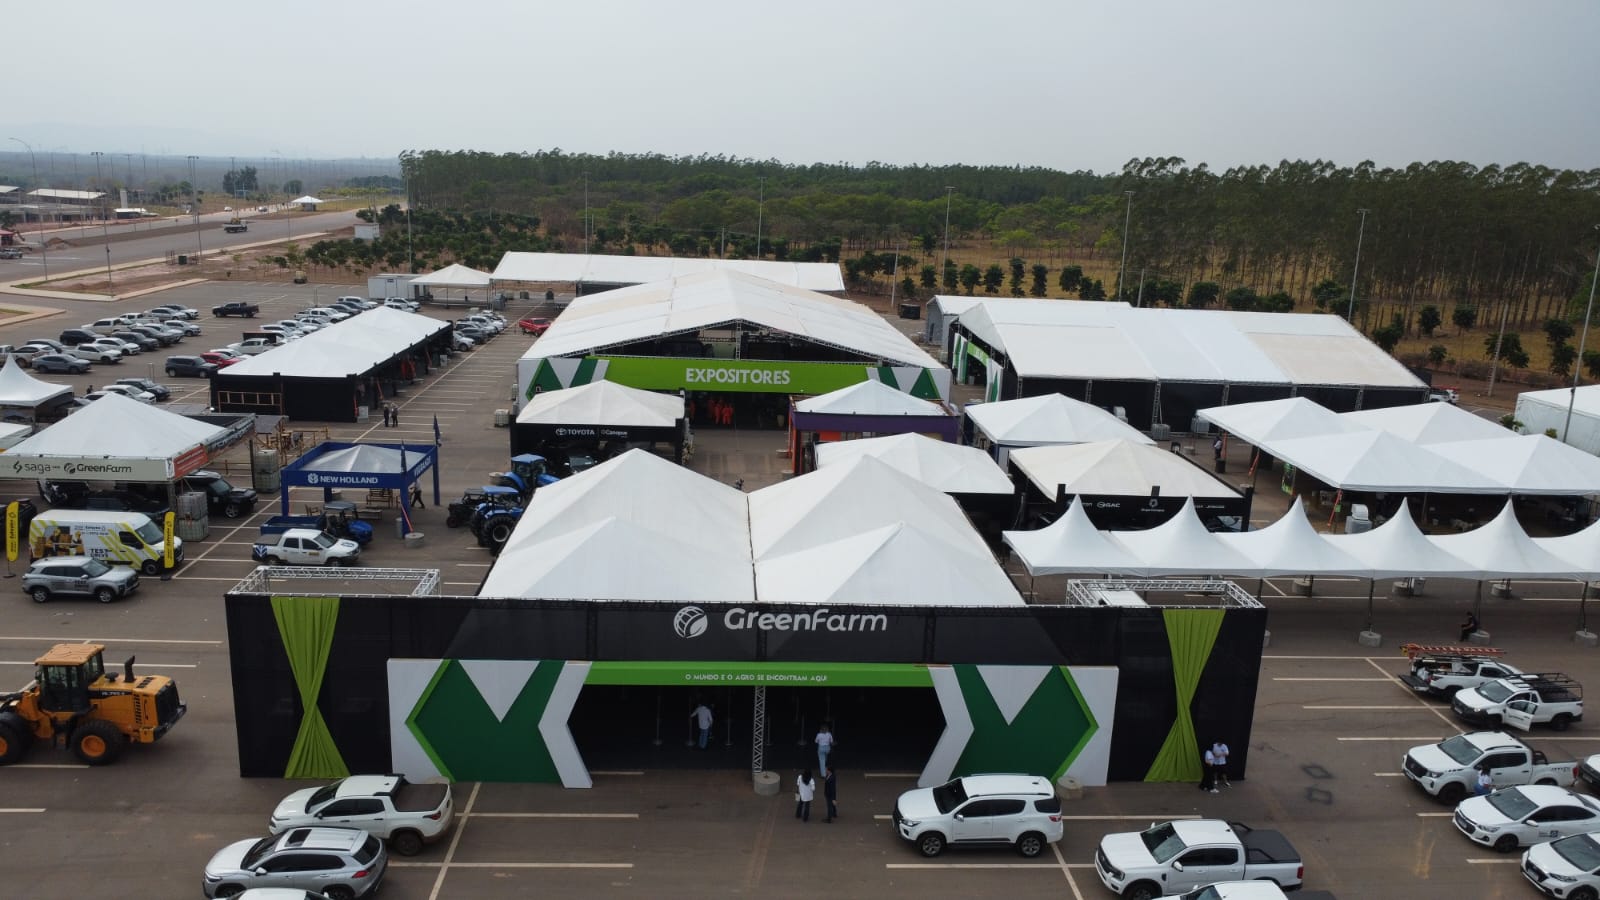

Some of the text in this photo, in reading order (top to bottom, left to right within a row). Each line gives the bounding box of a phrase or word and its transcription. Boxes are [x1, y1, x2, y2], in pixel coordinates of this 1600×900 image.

[685, 368, 791, 385] EXPOSITORES
[24, 463, 51, 474] saga
[76, 463, 132, 473] GreenFarm
[319, 475, 379, 484] NEW HOLLAND
[724, 607, 888, 632] GreenFarm
[766, 674, 808, 682] ENCONTRAM
[810, 675, 828, 683] AQUI
